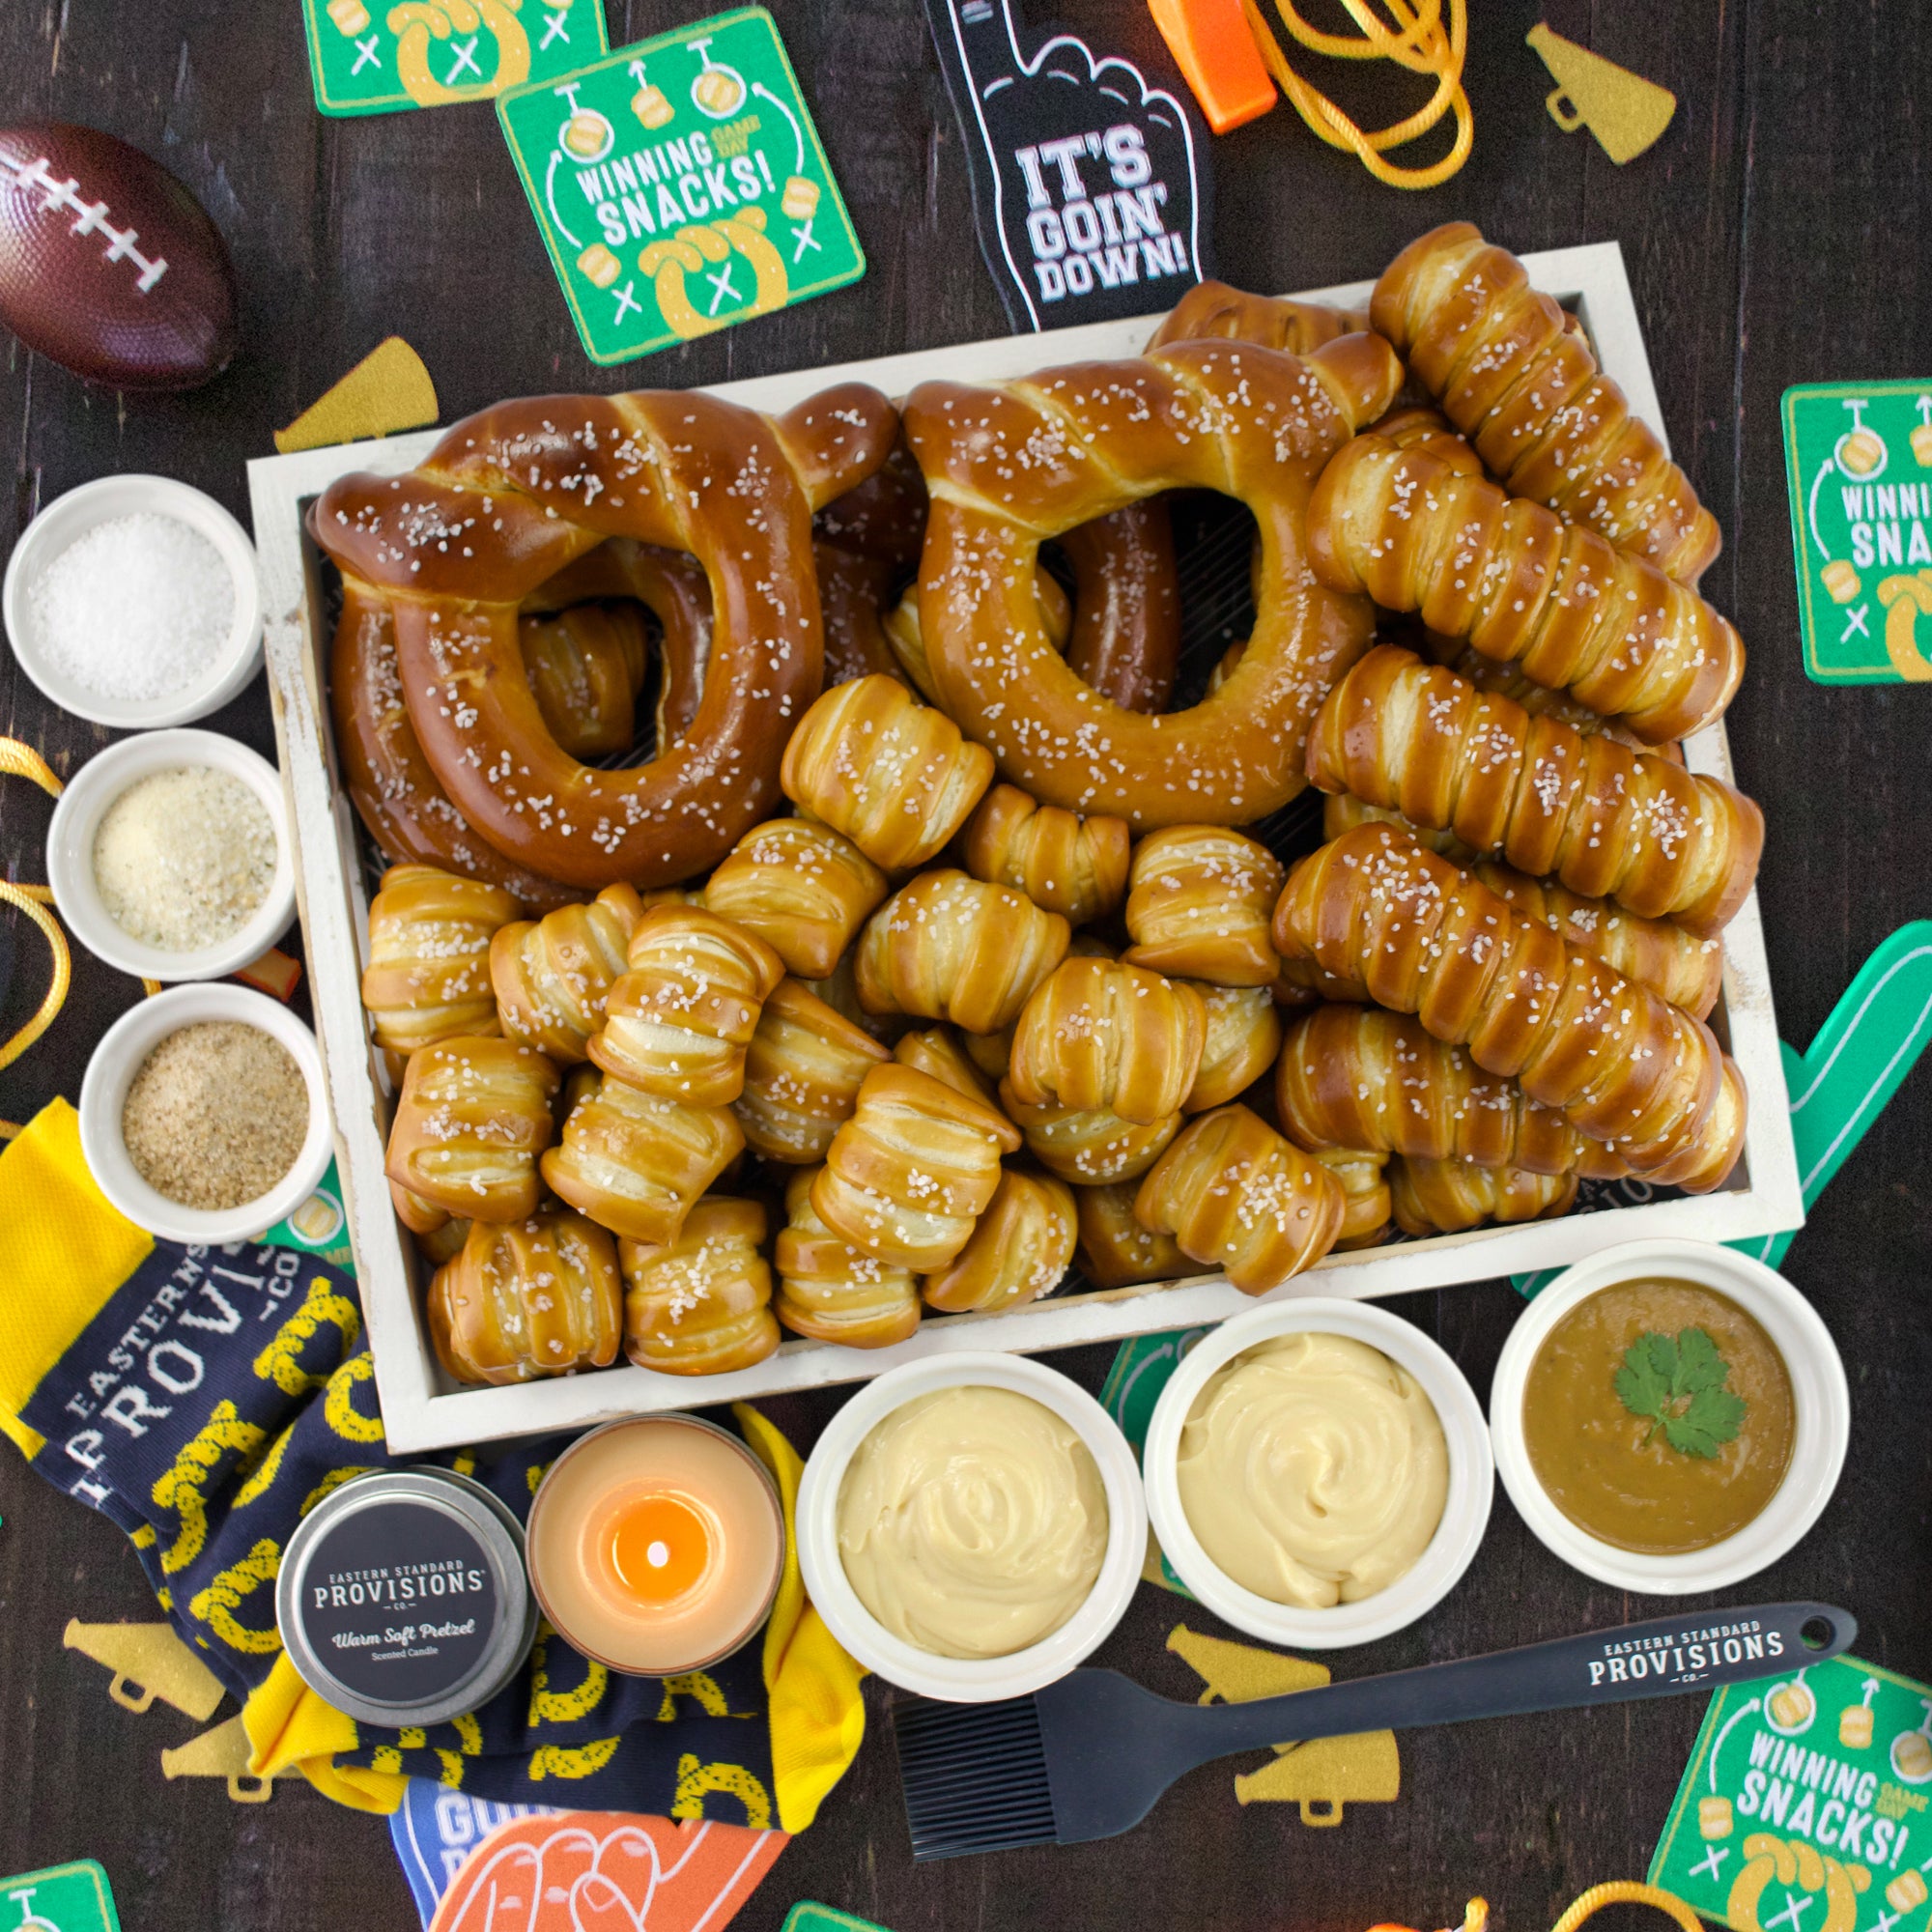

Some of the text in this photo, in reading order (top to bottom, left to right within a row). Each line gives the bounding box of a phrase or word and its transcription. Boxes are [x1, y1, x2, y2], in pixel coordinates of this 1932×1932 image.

[576, 130, 713, 206] WINNING
[596, 149, 777, 246] SNACKS!
[1014, 124, 1152, 210] IT'S
[1026, 182, 1167, 262] GOIN'
[1034, 232, 1190, 303] DOWN!
[1841, 482, 1932, 522] WINNI
[1851, 519, 1932, 569] SNA
[65, 1258, 204, 1420] EASTERN
[65, 1241, 274, 1510] PROVI
[314, 1570, 483, 1609] PROVISIONS
[329, 1559, 464, 1584] EASTERN STANDARD
[331, 1618, 476, 1649] Warm Soft Pretzel
[371, 1646, 440, 1662] Scented Candle
[1587, 1631, 1785, 1687] PROVISIONS
[1604, 1620, 1761, 1658] EASTERN STANDARD
[1748, 1729, 1878, 1809] WINNING
[1737, 1769, 1910, 1870] SNACKS!
